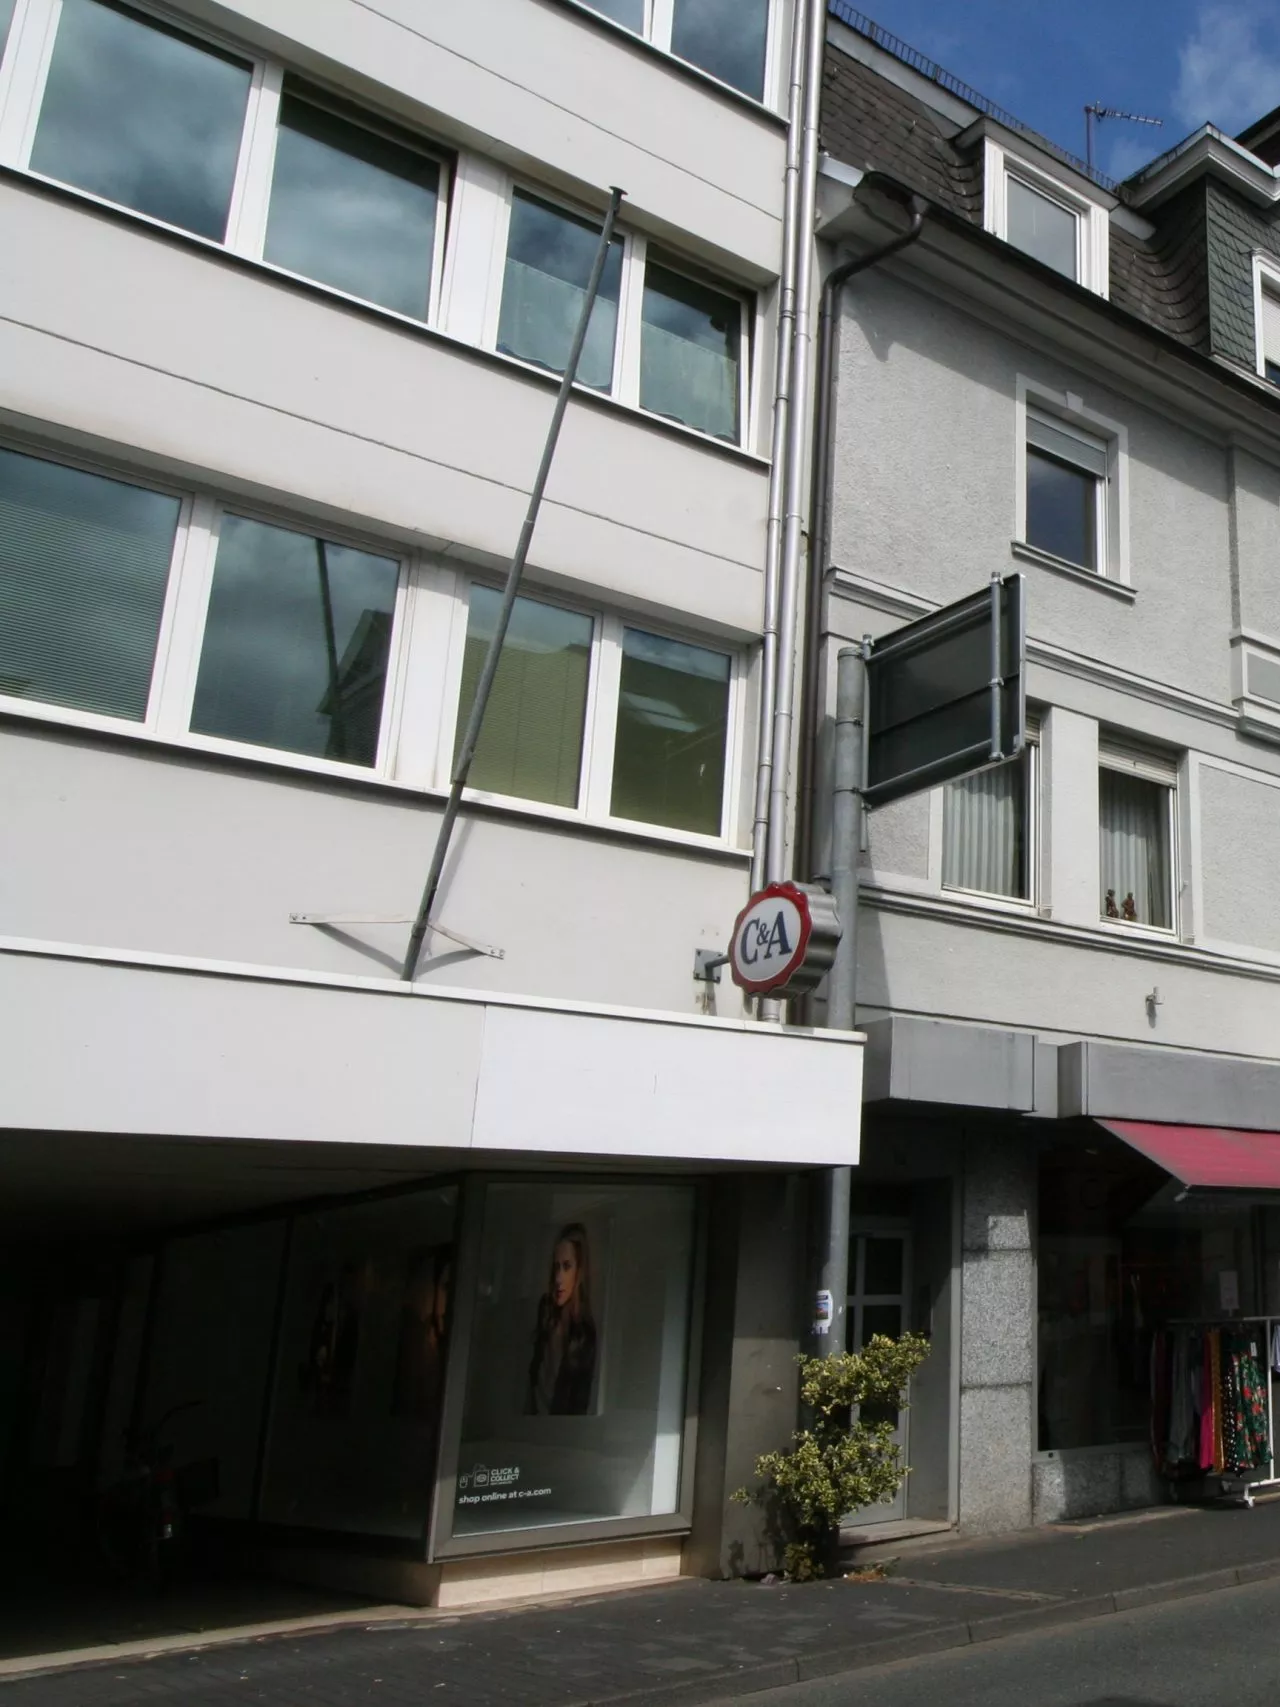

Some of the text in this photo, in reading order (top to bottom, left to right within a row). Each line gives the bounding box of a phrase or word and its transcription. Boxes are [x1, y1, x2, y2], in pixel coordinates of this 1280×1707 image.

[740, 910, 793, 965] C&A
[490, 1474, 519, 1482] COLLECT
[491, 1468, 513, 1476] CLICK
[459, 1487, 552, 1505] shop online at c-a.com
